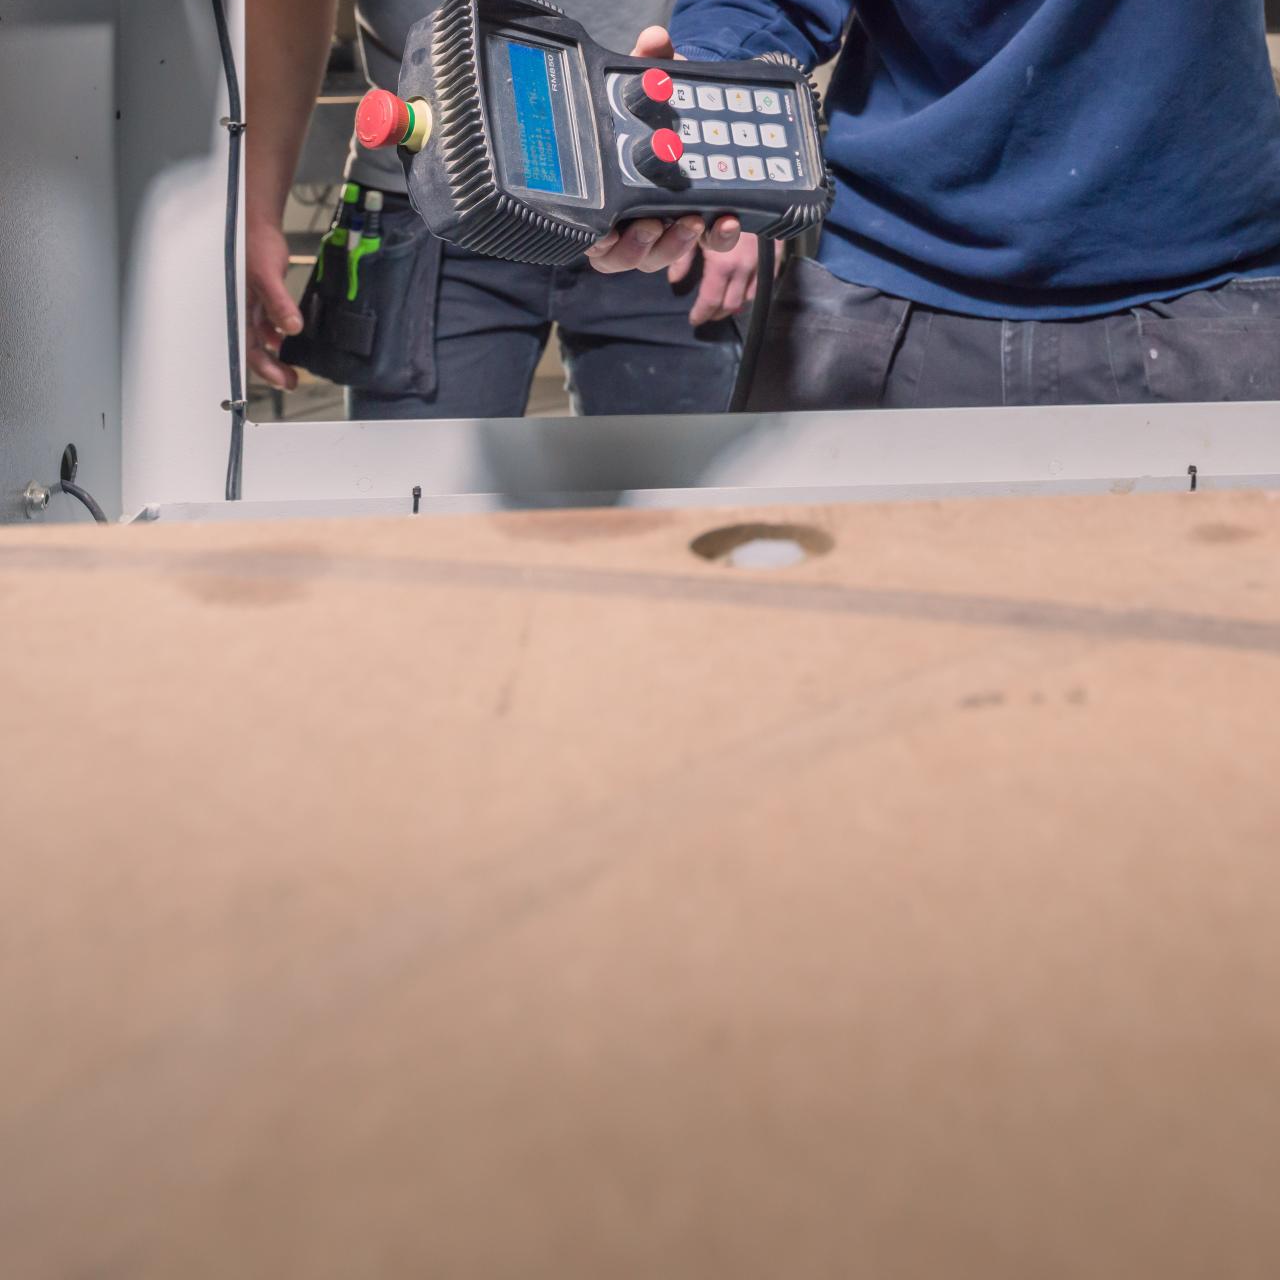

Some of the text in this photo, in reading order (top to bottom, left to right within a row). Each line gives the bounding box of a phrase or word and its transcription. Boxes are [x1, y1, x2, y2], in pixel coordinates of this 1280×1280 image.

[548, 54, 559, 92] RM850
[678, 89, 686, 101] F3
[683, 123, 691, 136] F2
[689, 160, 697, 171] F1
